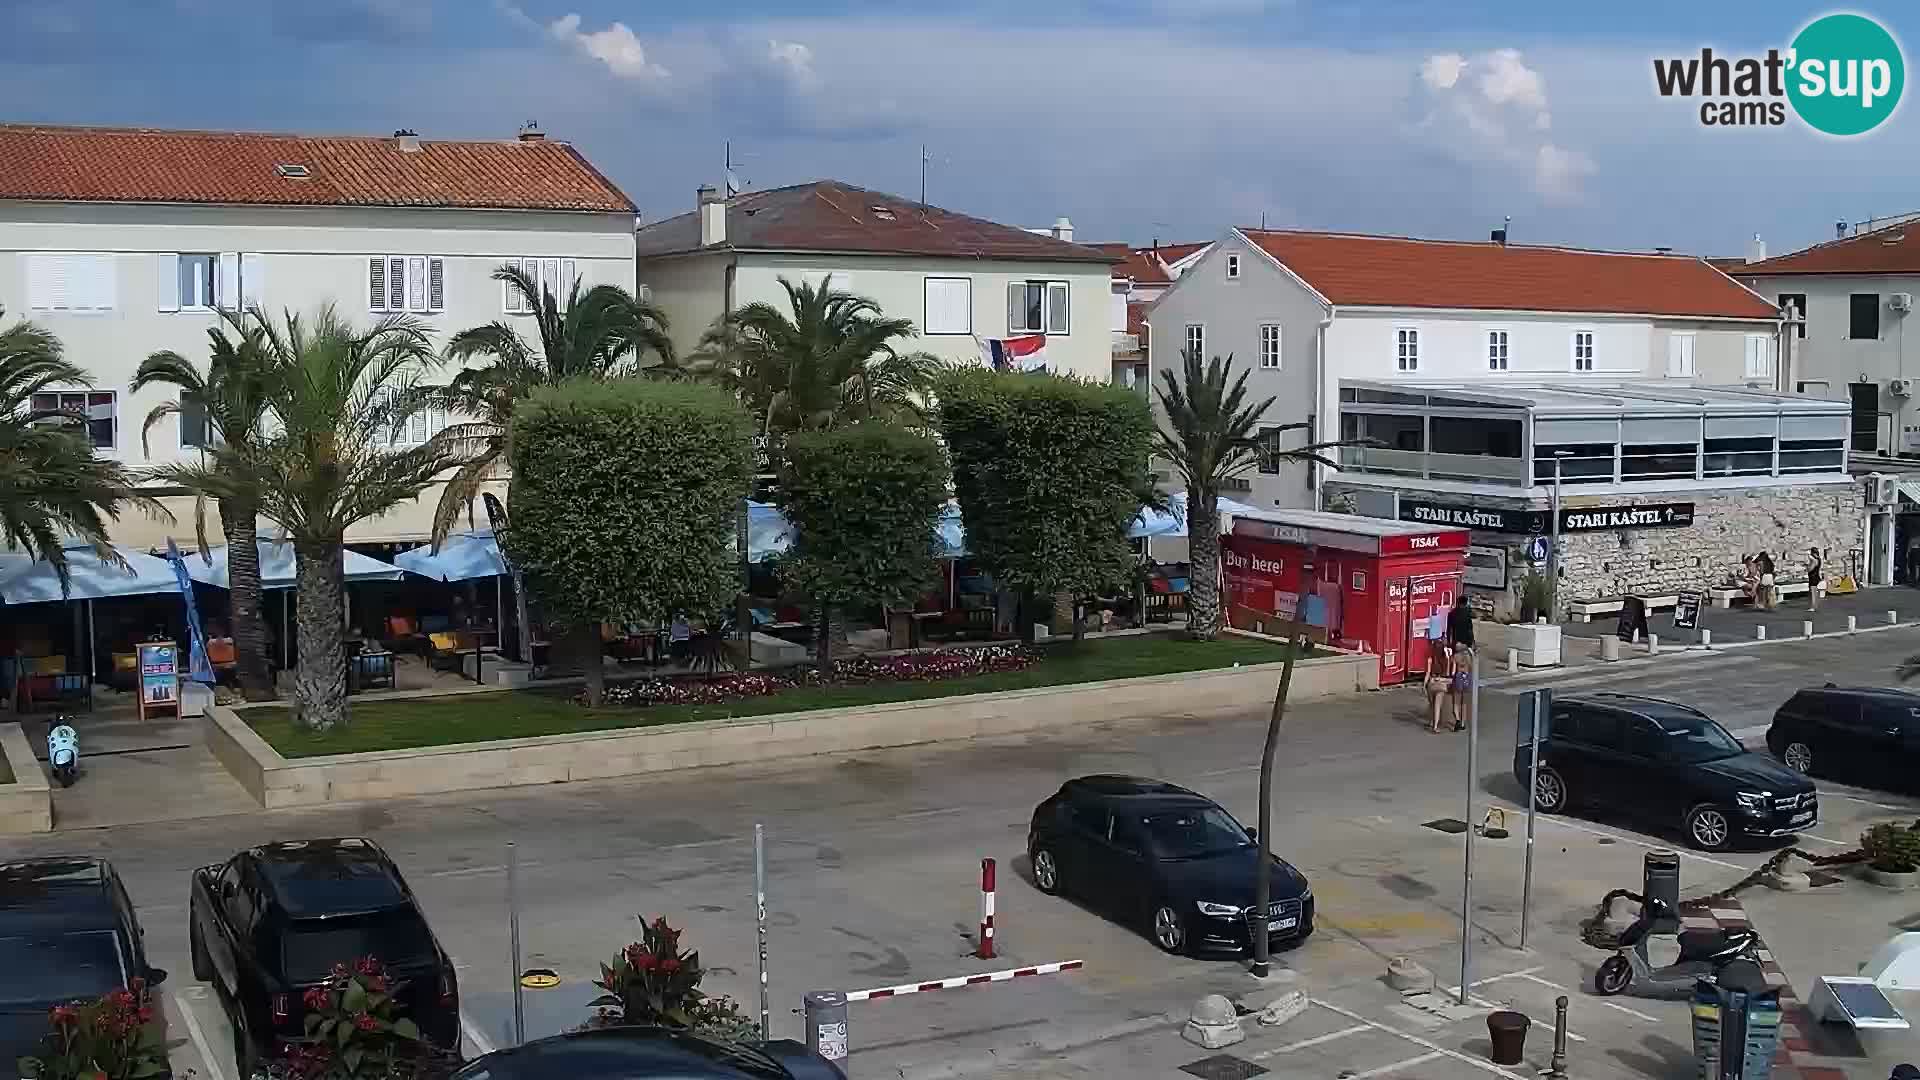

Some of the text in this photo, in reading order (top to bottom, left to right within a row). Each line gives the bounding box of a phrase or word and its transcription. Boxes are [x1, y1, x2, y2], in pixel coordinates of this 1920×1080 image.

[1414, 507, 1504, 528] STARI KAŠTEL
[1566, 513, 1608, 529] STARI
[1609, 508, 1662, 526] KAŠTEL
[1410, 536, 1440, 549] TISAK
[1226, 550, 1285, 576] Buy here!
